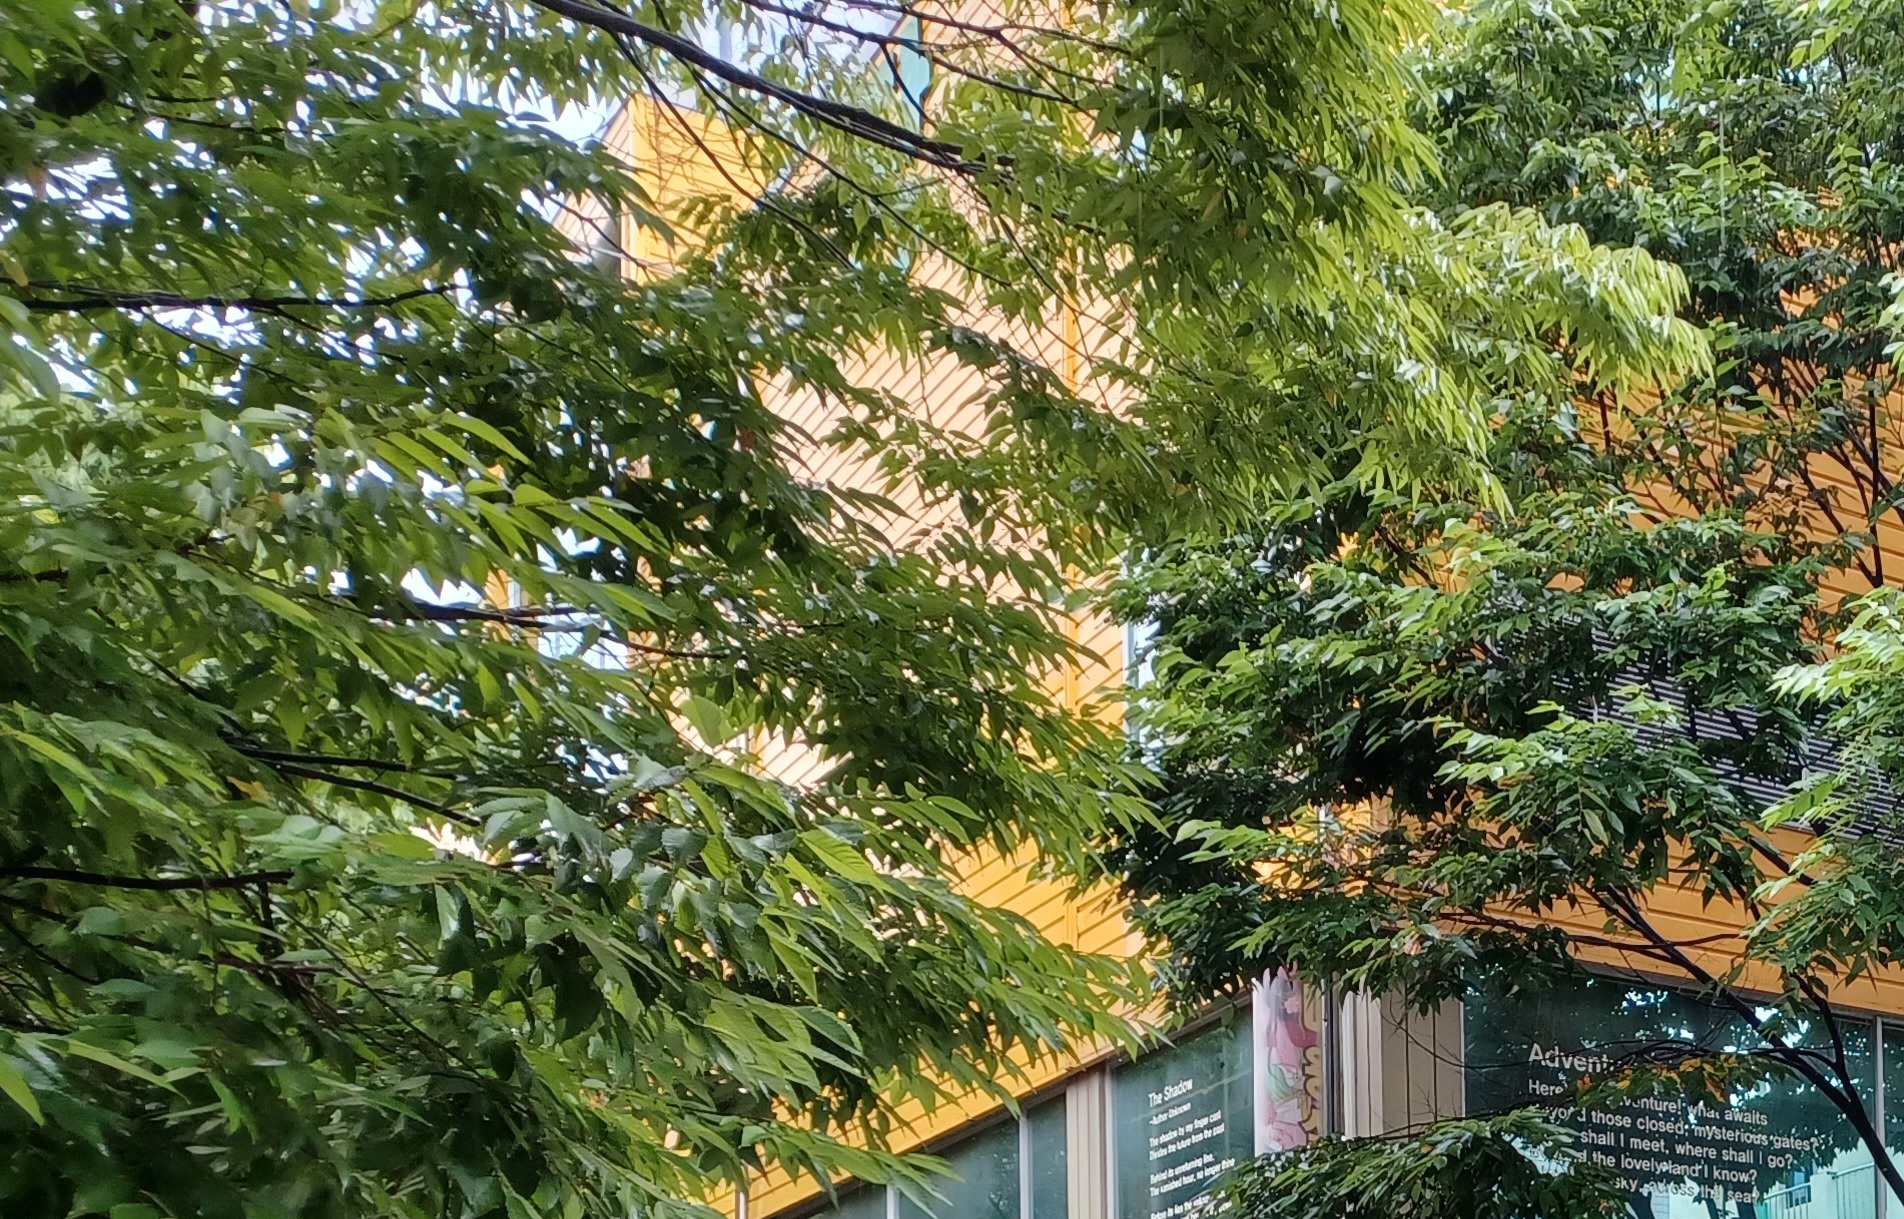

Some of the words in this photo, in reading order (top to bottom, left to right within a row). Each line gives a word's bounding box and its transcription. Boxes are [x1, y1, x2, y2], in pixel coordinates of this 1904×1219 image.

[1528, 1043, 1611, 1074] Advent
[1149, 1092, 1162, 1107] The
[1164, 1079, 1193, 1101] Shadow
[1591, 1109, 1632, 1128] those
[1693, 1125, 1768, 1146] mysterious
[1773, 1134, 1819, 1152] gates?
[1724, 1109, 1768, 1126] awaits
[1580, 1129, 1615, 1146] shall
[1620, 1133, 1624, 1148] I
[1629, 1139, 1669, 1155] meet,
[1674, 1141, 1717, 1159] where
[1721, 1147, 1754, 1164] shall
[1767, 1153, 1793, 1170] go?
[1592, 1151, 1616, 1167] the
[1620, 1154, 1661, 1174] lovely
[1668, 1160, 1700, 1177] land
[1713, 1166, 1758, 1185] know?
